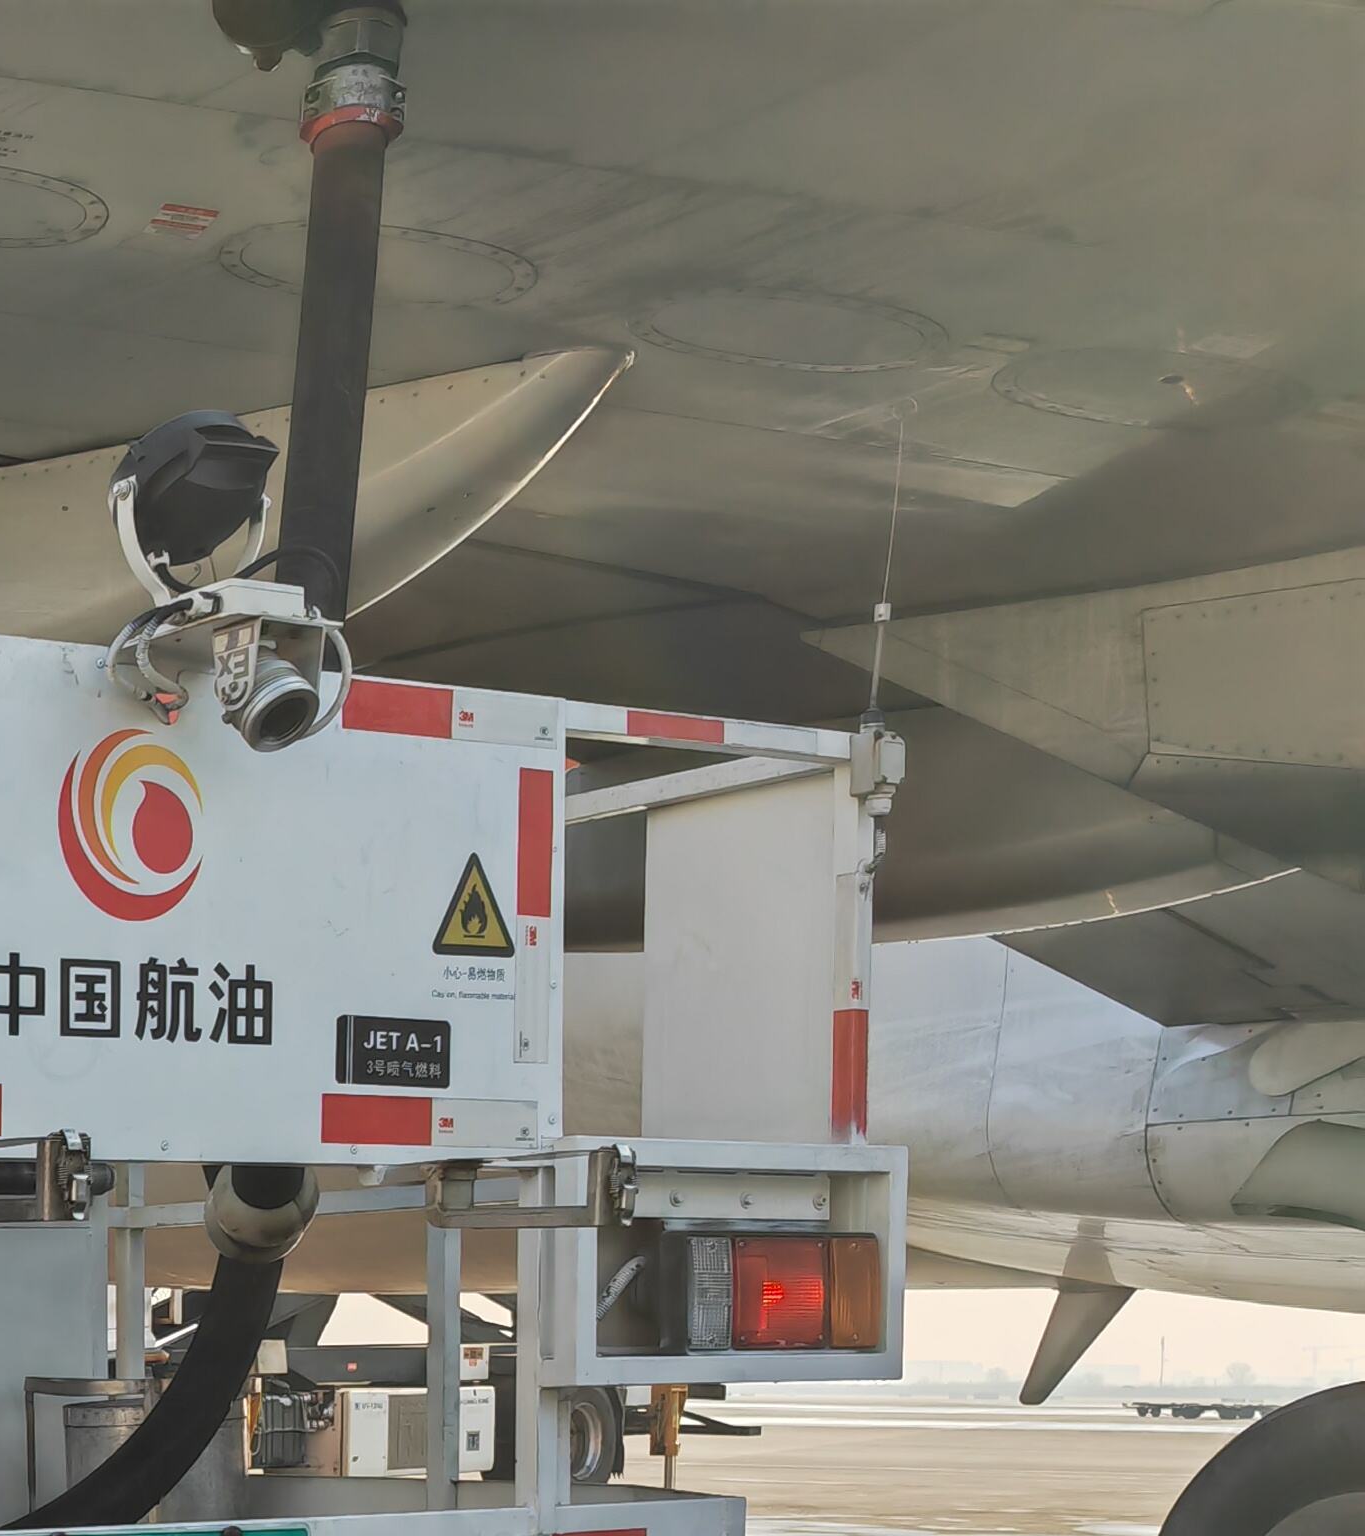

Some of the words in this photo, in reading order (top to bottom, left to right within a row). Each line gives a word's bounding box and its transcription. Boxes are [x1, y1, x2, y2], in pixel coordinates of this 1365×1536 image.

[363, 1030, 401, 1050] JET
[405, 1033, 442, 1053] A-1
[366, 1060, 442, 1079] 3号喷气燃料
[438, 1117, 454, 1128] 3M
